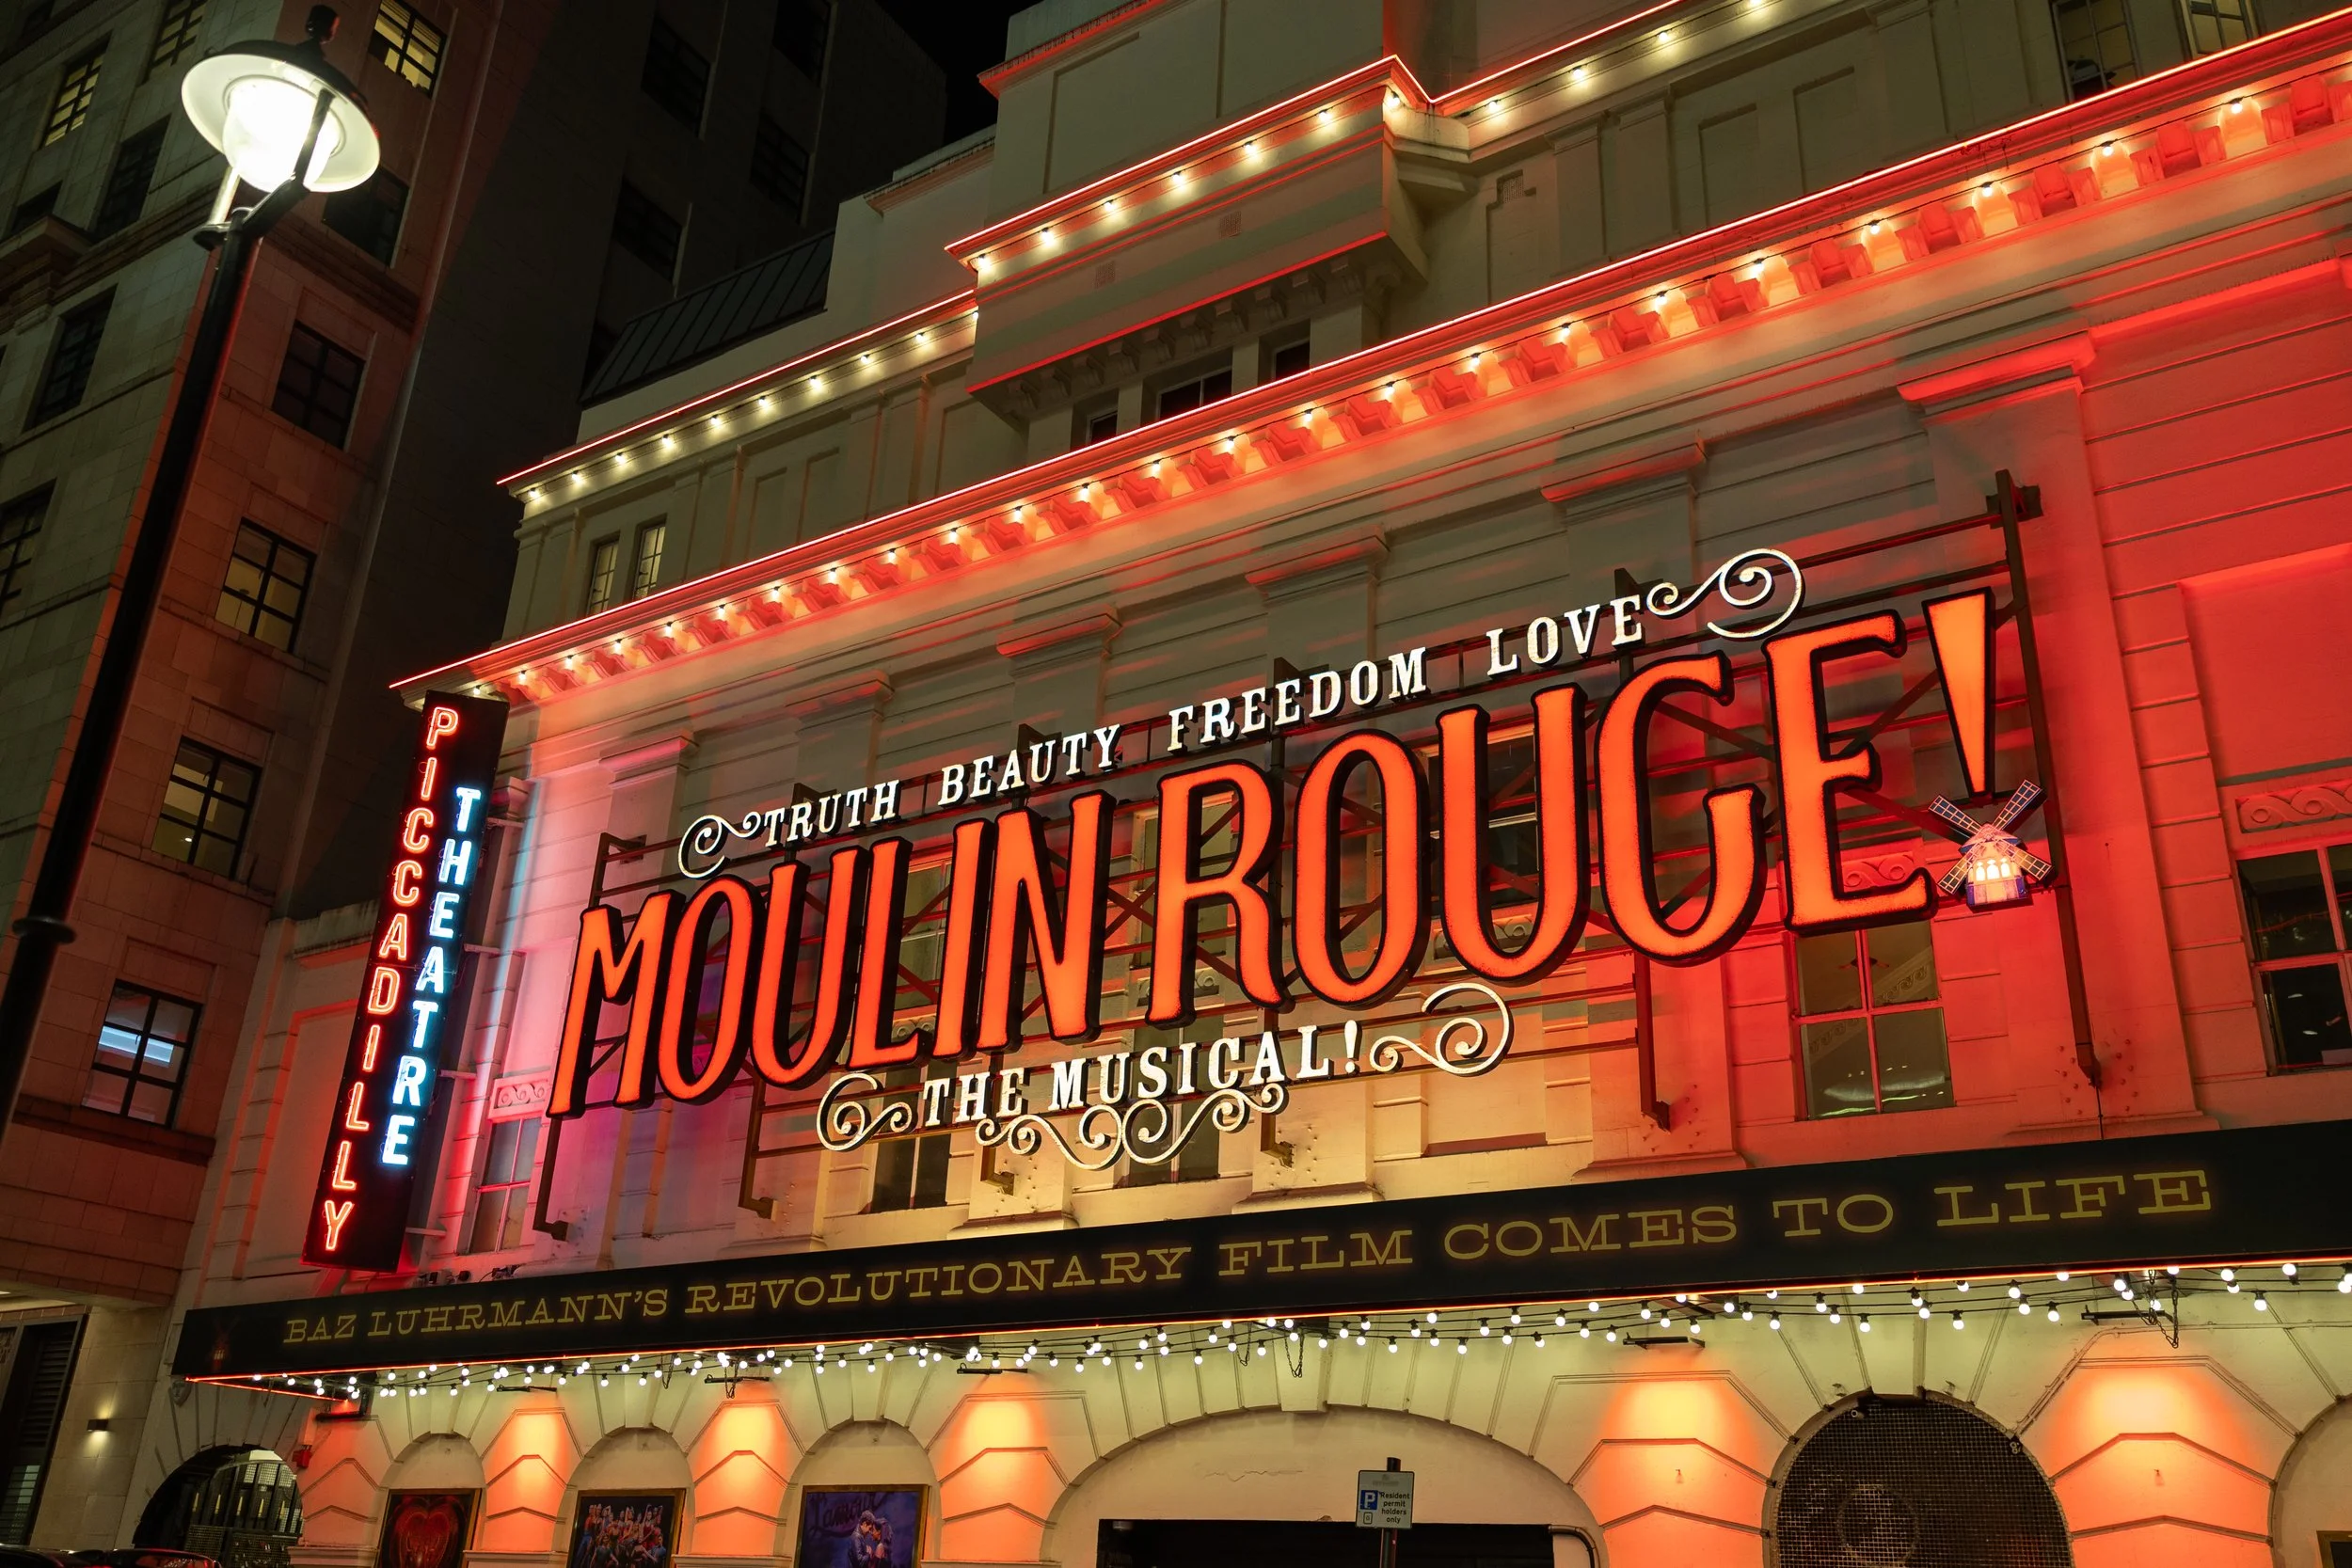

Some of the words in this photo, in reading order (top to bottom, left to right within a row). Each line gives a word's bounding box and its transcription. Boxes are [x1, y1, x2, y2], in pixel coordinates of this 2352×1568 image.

[547, 789, 1113, 1117] MOULIN
[1146, 588, 1996, 1028] ROUGE!
[764, 780, 899, 847] TRUTH
[937, 723, 1121, 806] BEAUTY
[1168, 646, 1429, 752] FREEDOM
[1486, 594, 1643, 675] LOVE
[324, 705, 459, 1253] PICCADILLY
[381, 786, 482, 1166] THEATRE
[923, 1068, 1029, 1126] THE
[1048, 1020, 1361, 1111] MUSICAL!
[283, 1315, 357, 1343] BAZ
[367, 1289, 669, 1336] LUHRMANN'S
[685, 1246, 1192, 1314] REVOLUTIONARY
[1218, 1230, 1413, 1275] FILM
[1444, 1205, 1737, 1260] COMES
[1772, 1194, 1894, 1237] TO
[1934, 1170, 2212, 1227] LIFE
